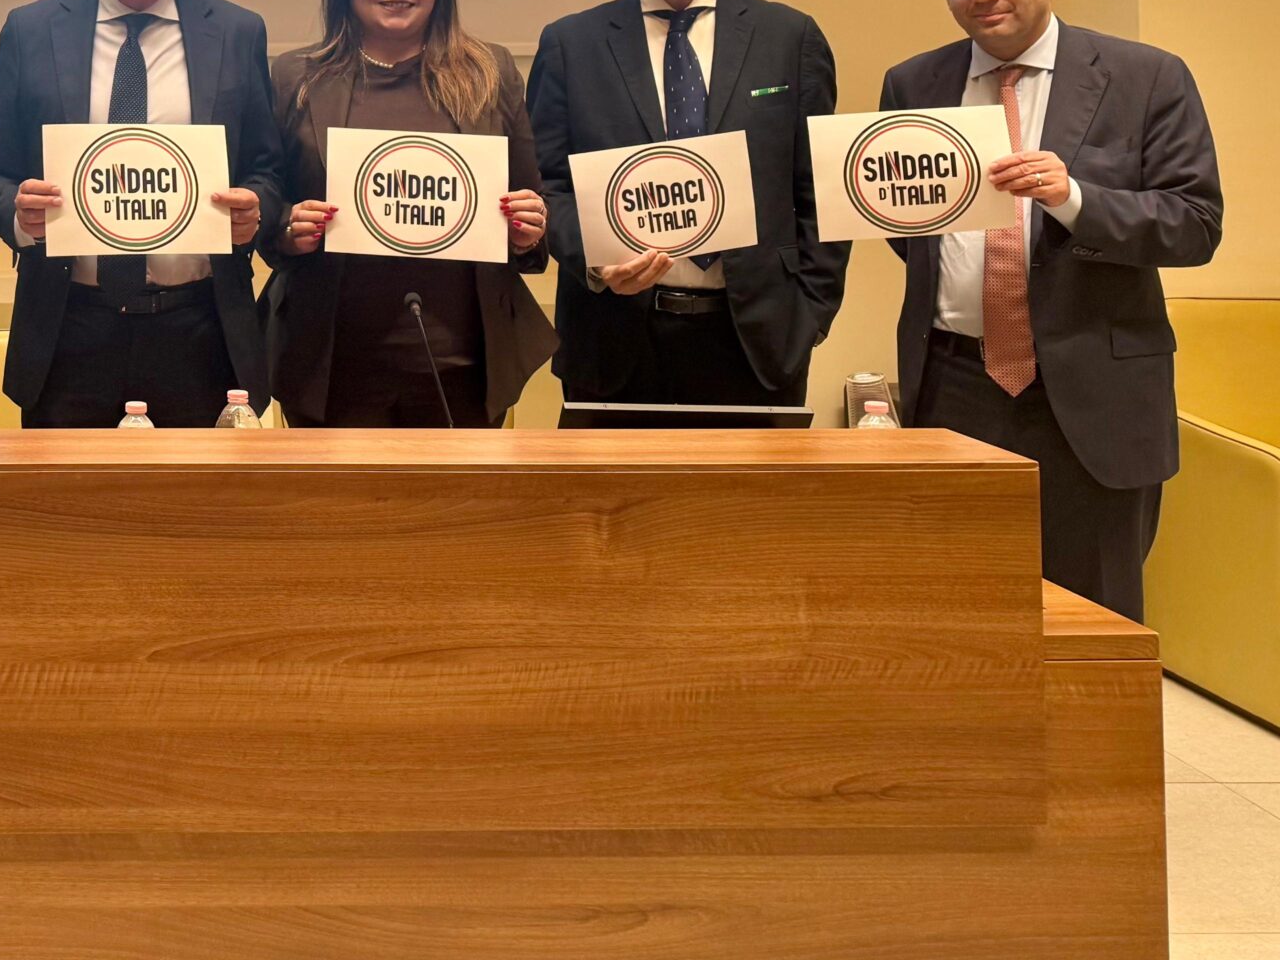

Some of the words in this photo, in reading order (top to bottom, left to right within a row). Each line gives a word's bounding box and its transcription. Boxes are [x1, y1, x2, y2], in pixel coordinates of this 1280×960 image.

[90, 163, 178, 194] SINDACI
[862, 150, 958, 183] SINDACI
[372, 169, 457, 202] SINDACI
[621, 178, 706, 213] SINDACI
